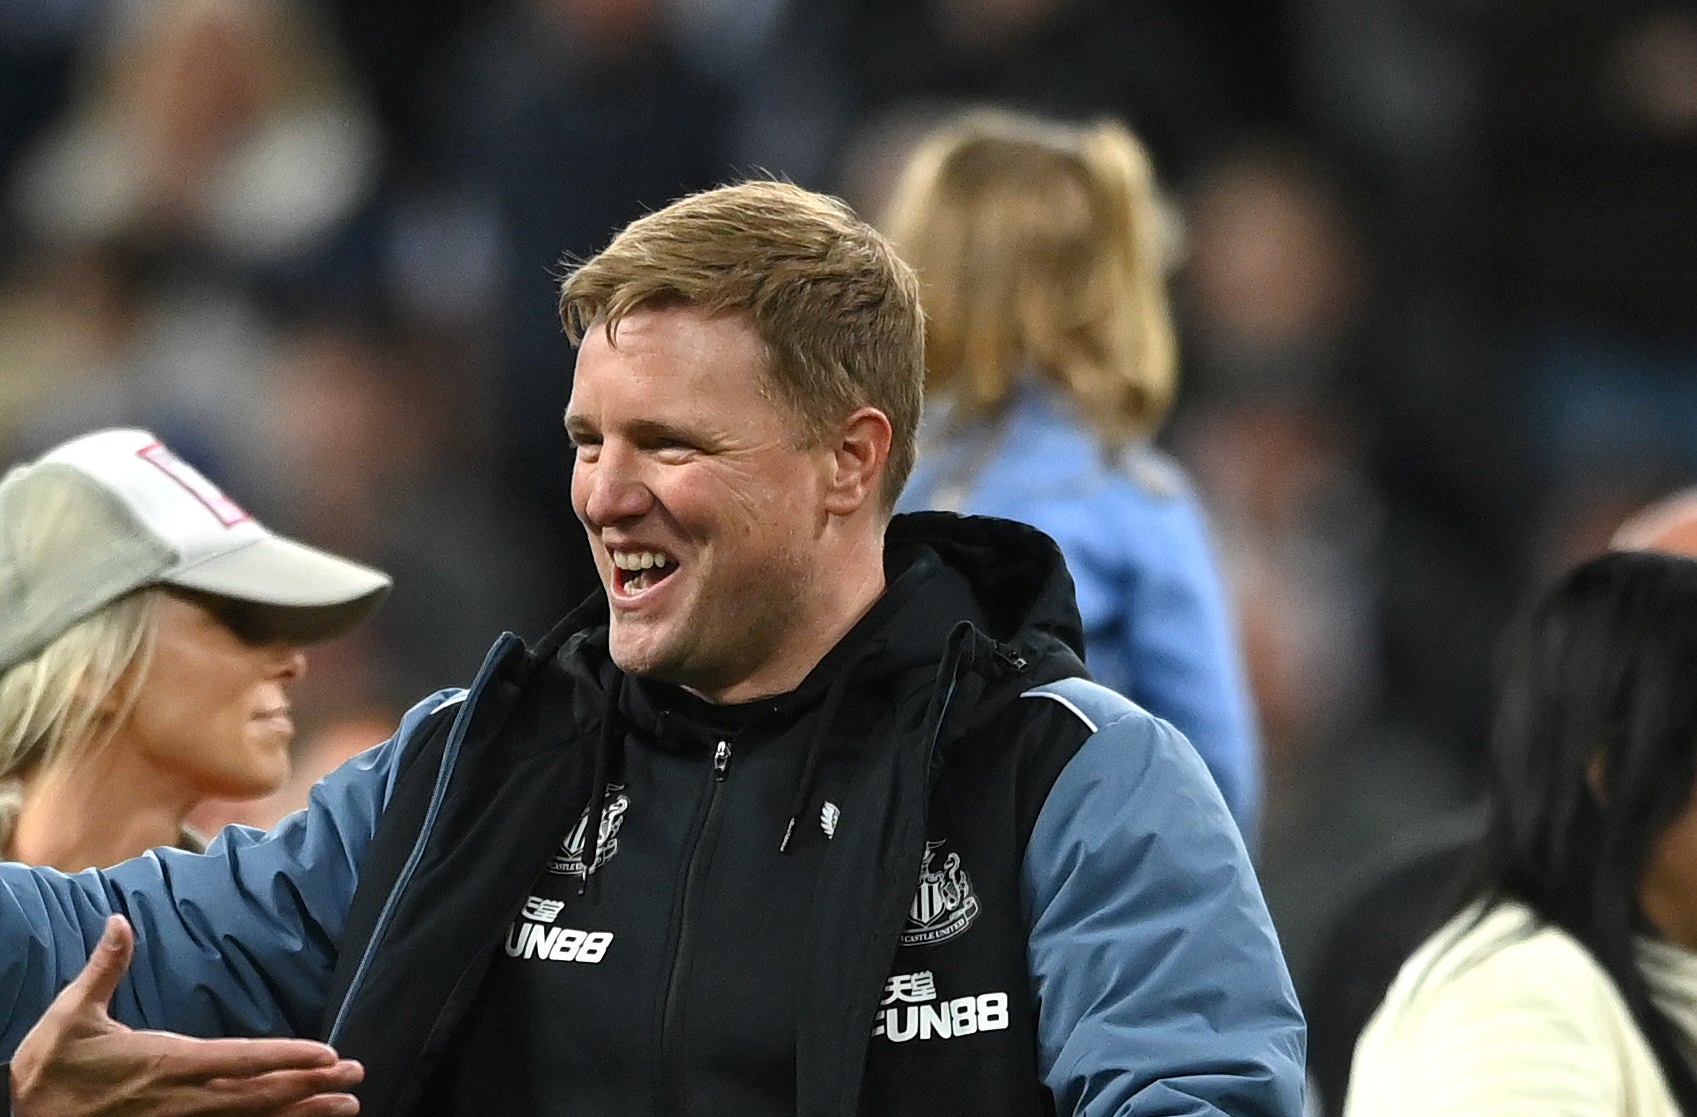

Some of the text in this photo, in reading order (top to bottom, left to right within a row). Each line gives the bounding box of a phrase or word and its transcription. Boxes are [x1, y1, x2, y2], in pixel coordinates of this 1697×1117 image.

[505, 922, 614, 963] UN88
[935, 918, 965, 938] UNITED
[880, 970, 937, 1005] 天堂
